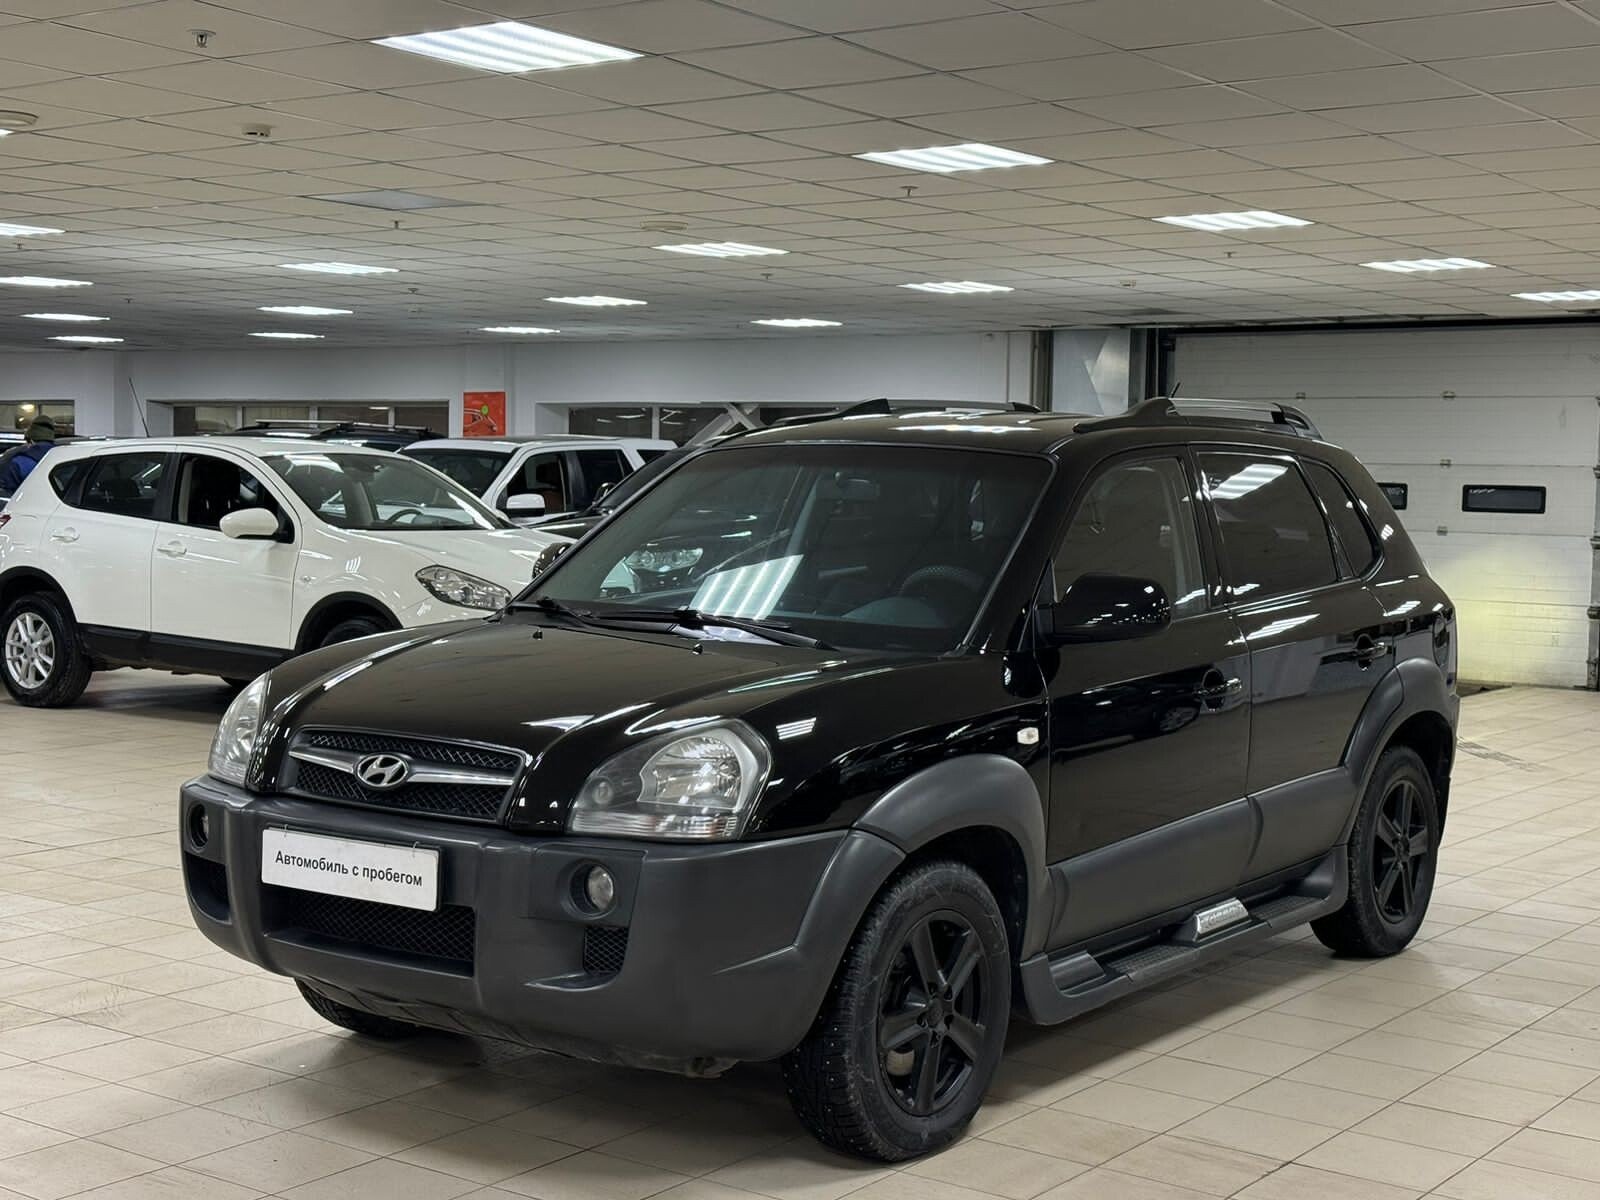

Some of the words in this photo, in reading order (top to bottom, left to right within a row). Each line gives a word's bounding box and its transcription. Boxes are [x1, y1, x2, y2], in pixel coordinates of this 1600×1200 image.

[275, 850, 349, 875] Автомобиль
[352, 865, 359, 876] с
[362, 866, 423, 887] пробегом
